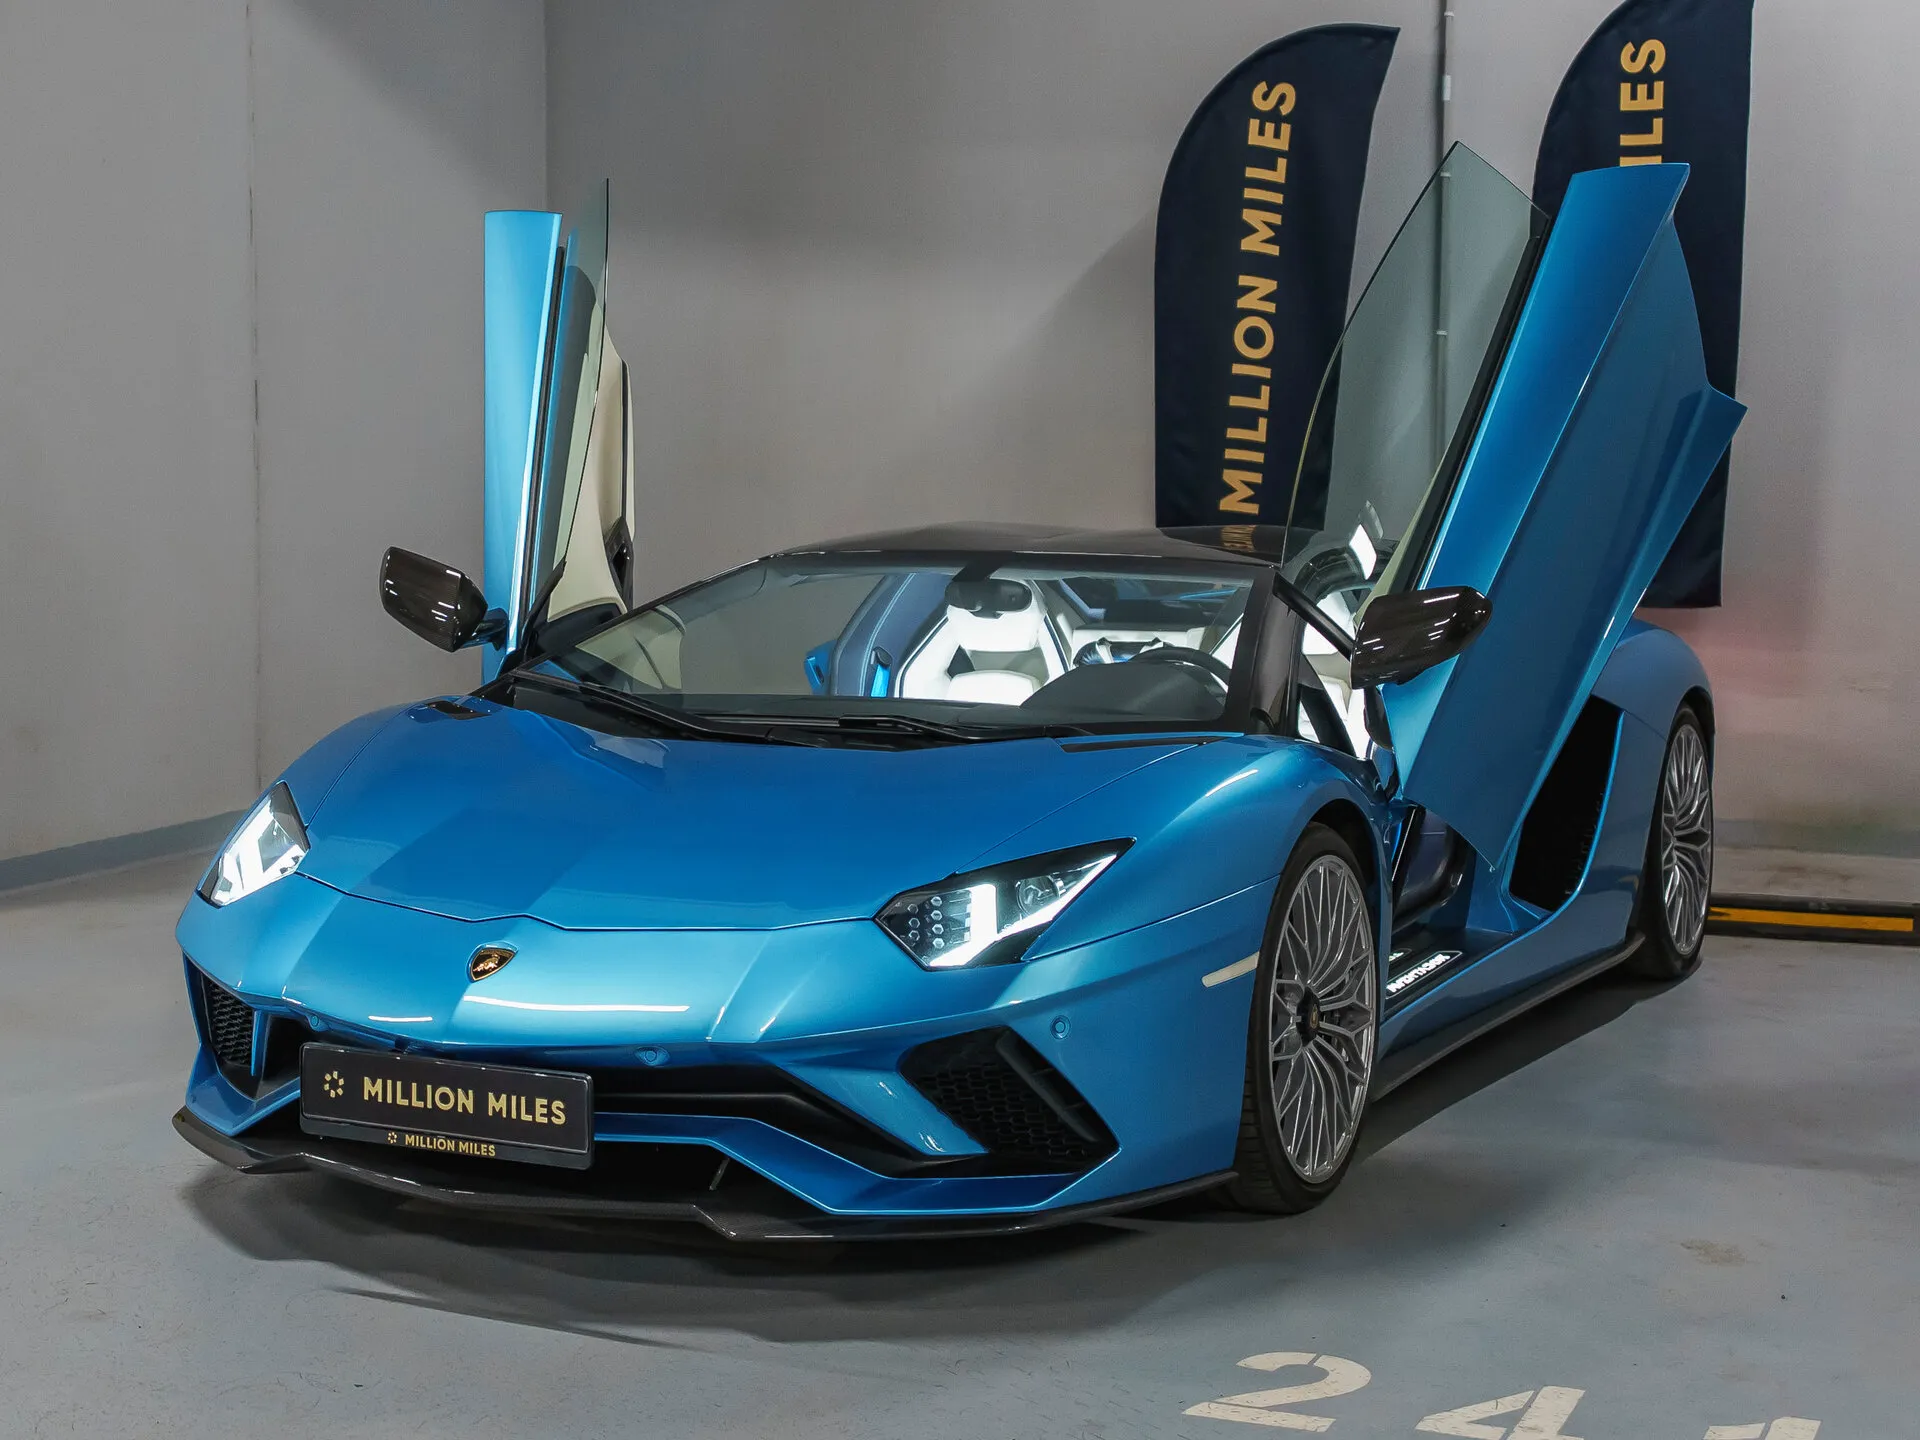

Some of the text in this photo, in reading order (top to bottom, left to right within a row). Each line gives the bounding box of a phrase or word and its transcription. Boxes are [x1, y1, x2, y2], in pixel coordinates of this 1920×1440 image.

[1619, 38, 1667, 167] ILES
[1240, 80, 1297, 257] MILES
[1218, 274, 1278, 516] MILLION
[362, 1076, 567, 1126] MILLION MILES
[404, 1133, 496, 1158] MILLION MILES
